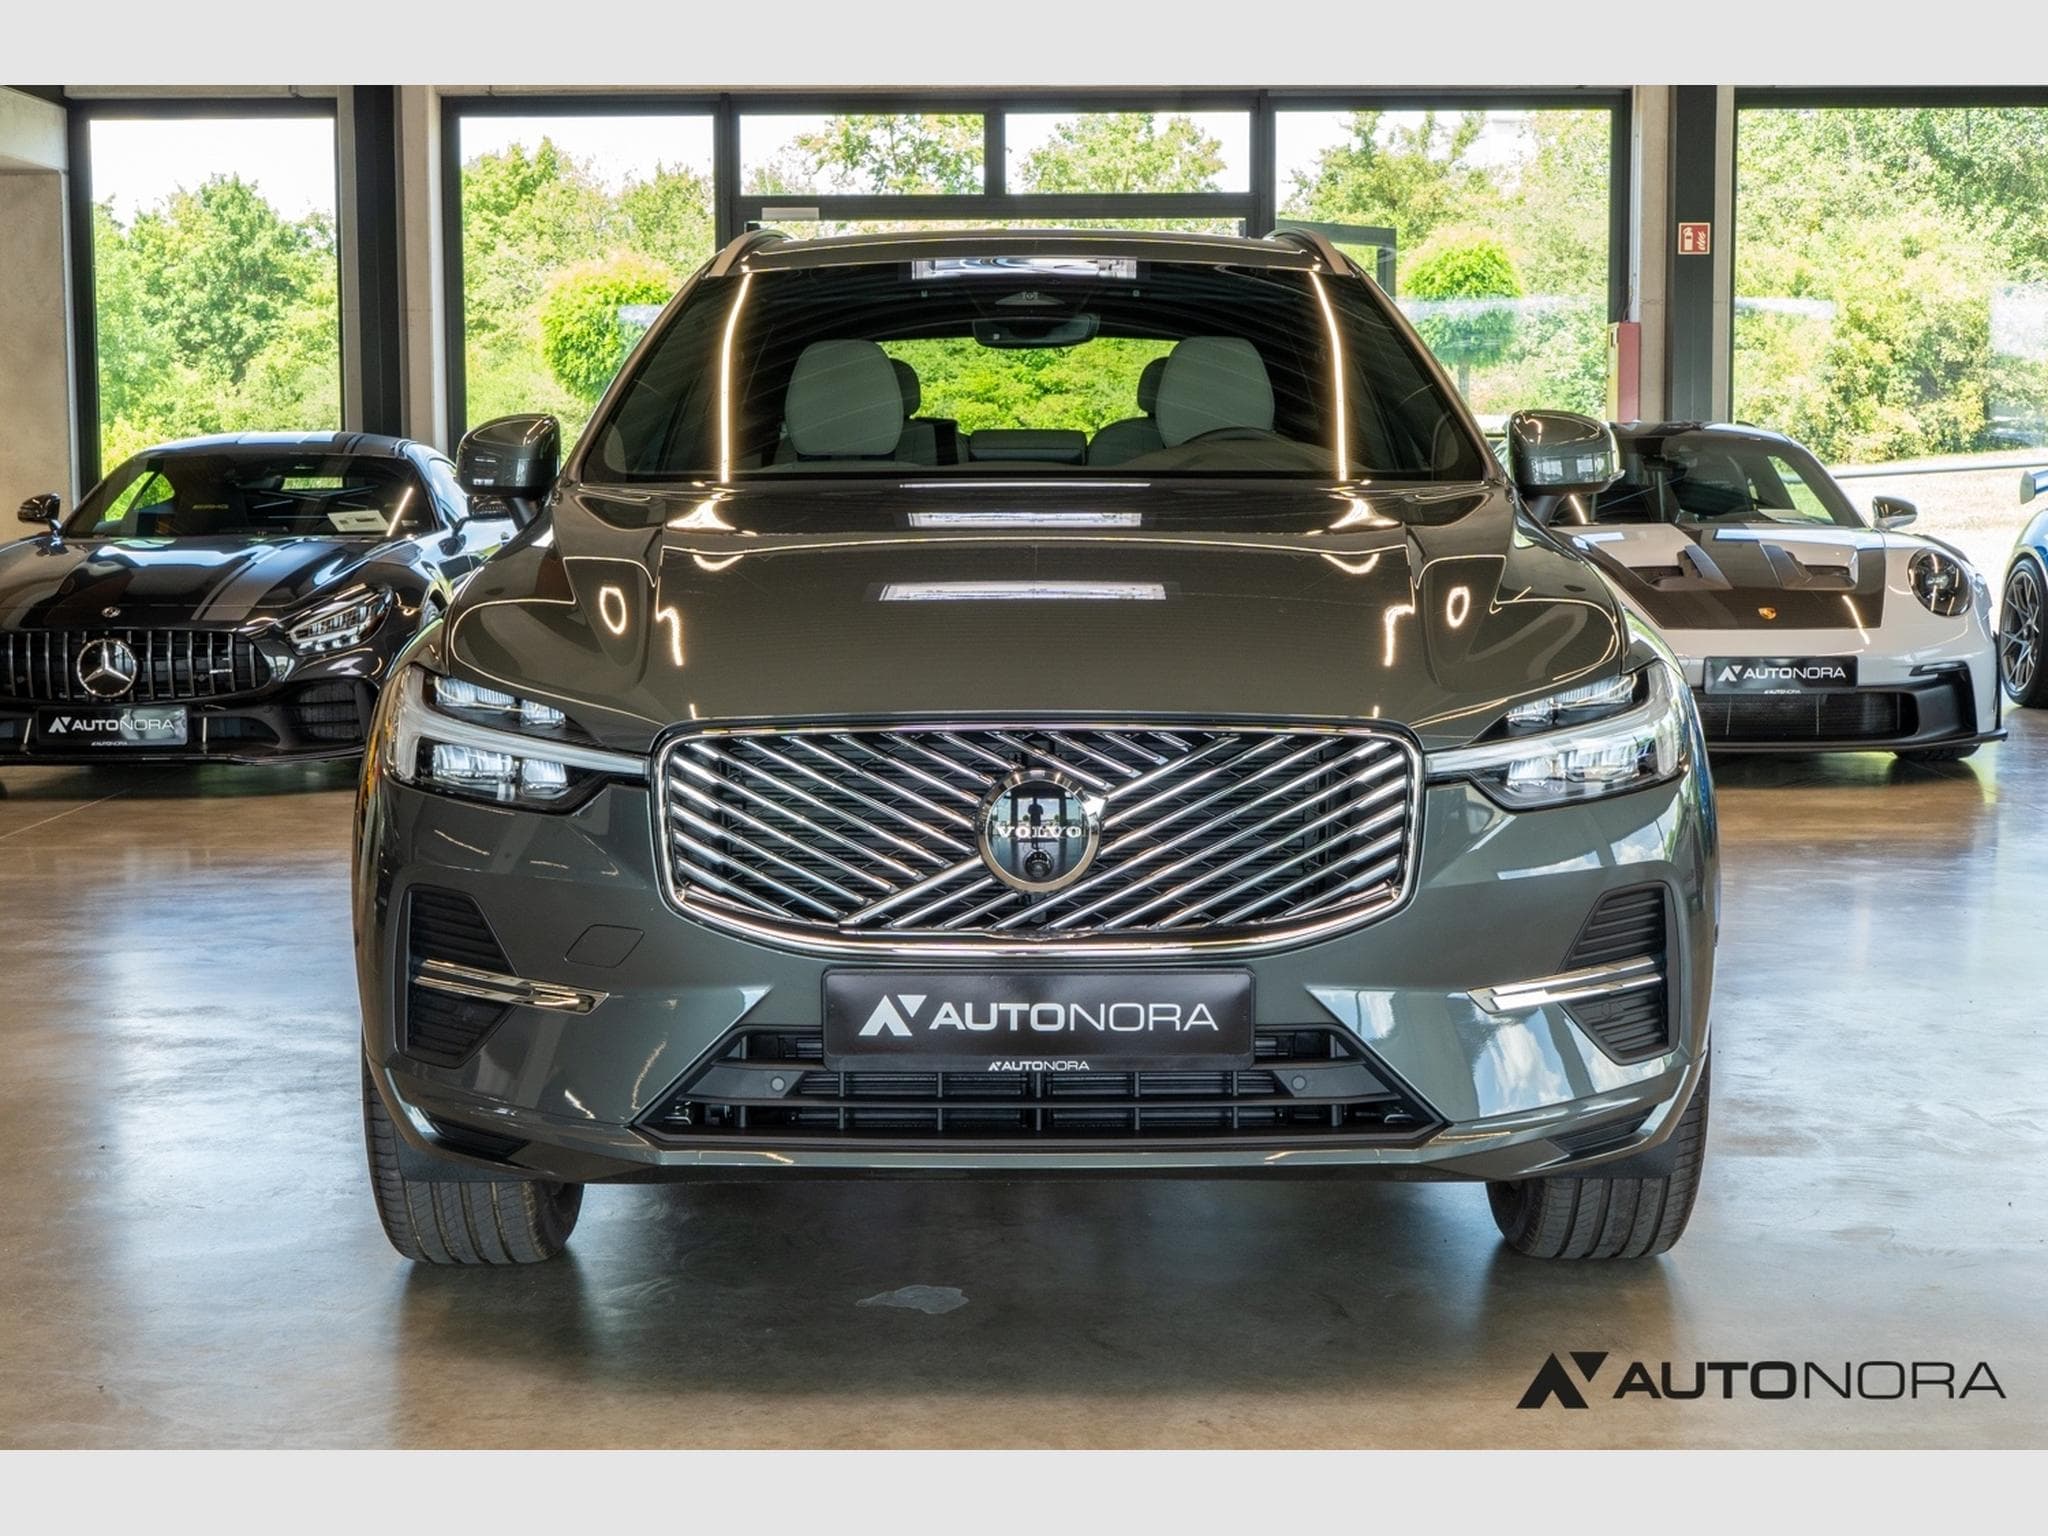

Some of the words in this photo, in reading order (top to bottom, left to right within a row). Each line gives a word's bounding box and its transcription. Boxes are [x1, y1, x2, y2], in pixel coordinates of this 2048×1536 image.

[1743, 667, 1846, 679] AUTONORA
[71, 719, 175, 731] AUTONORA
[997, 826, 1082, 838] VOLVO
[928, 1002, 1219, 1031] AUTONORA
[1001, 1060, 1090, 1071] AUTONORA
